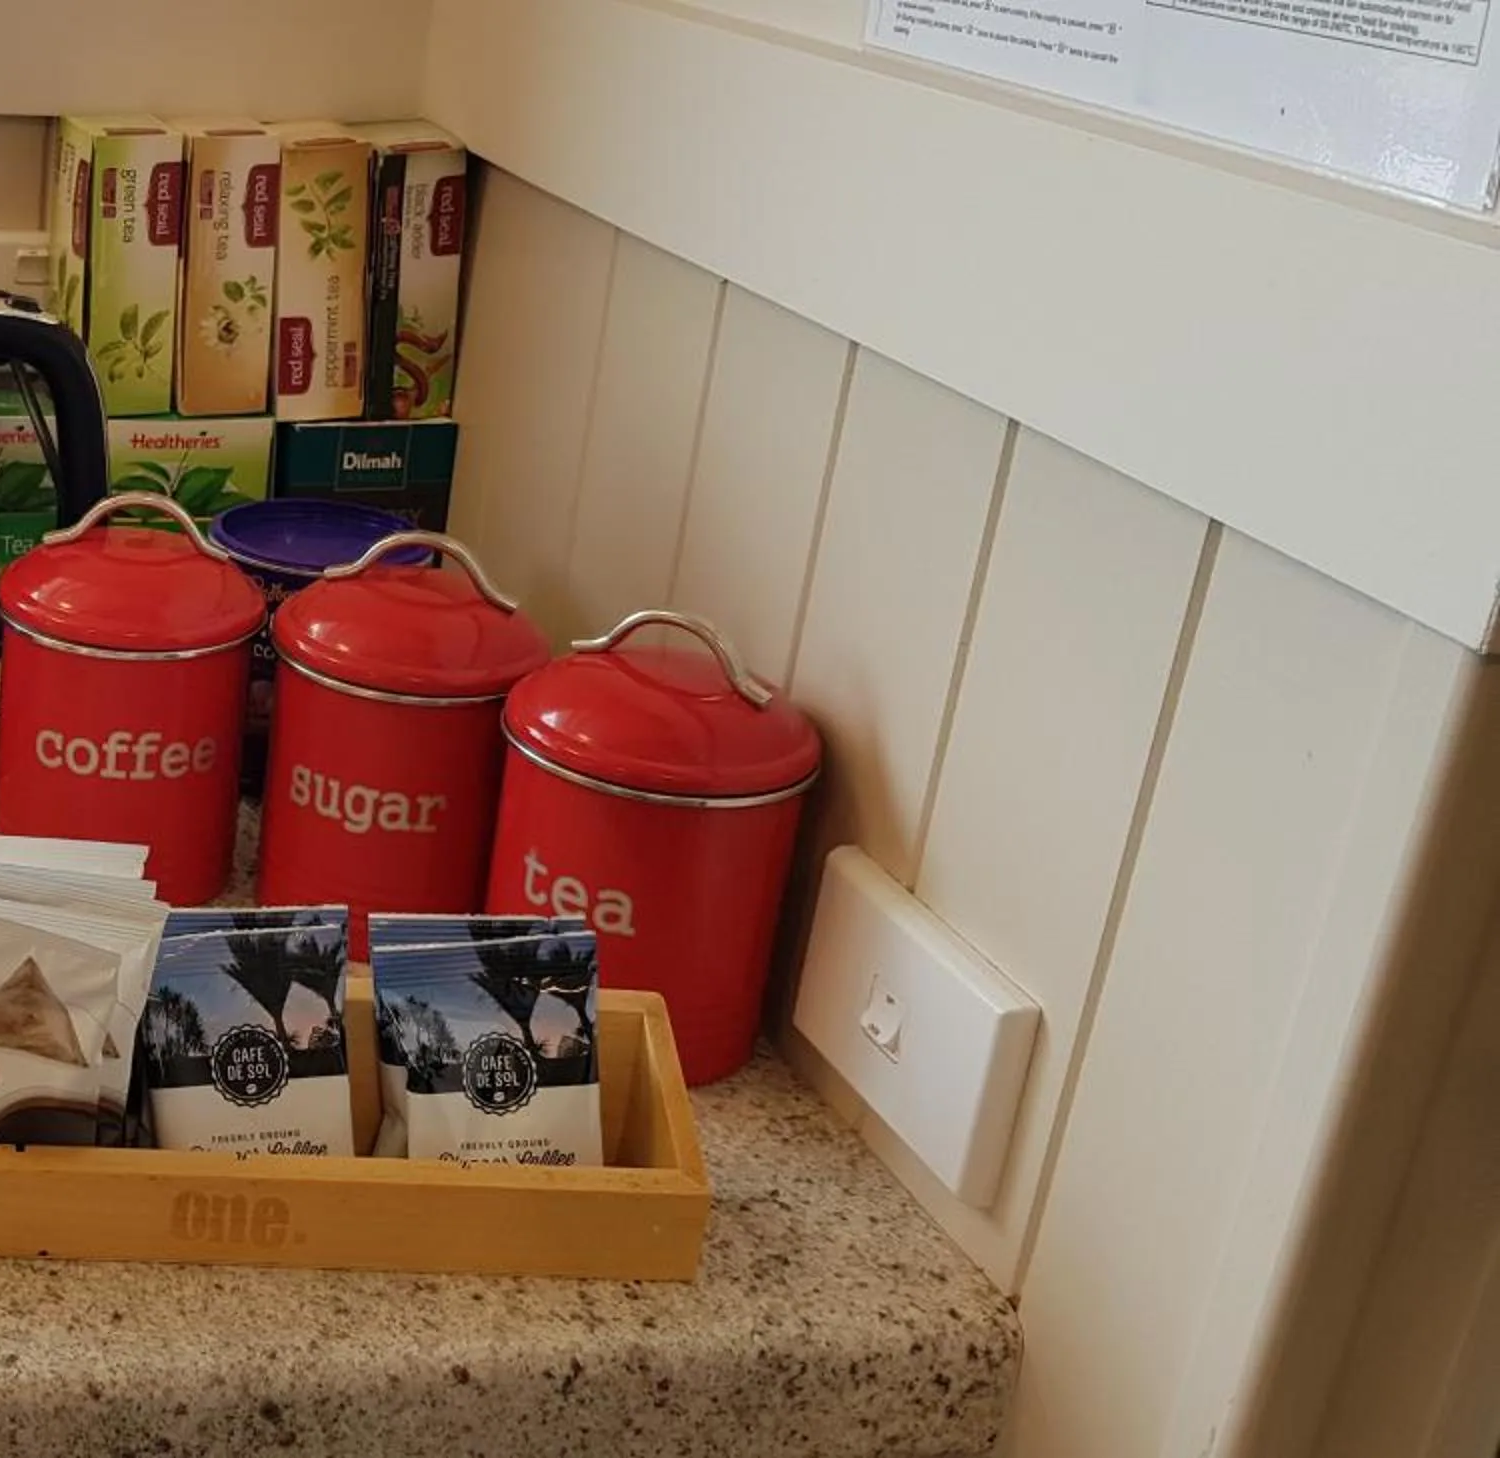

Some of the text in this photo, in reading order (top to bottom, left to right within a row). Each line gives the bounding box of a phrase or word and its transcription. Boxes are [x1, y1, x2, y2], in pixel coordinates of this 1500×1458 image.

[120, 168, 137, 243] green tea
[156, 172, 171, 236] red seal
[213, 170, 232, 261] relaxing tea
[253, 174, 267, 238] red seal
[438, 185, 454, 247] red seal
[288, 327, 305, 386] red seal
[325, 275, 341, 389] peppermint tea
[130, 430, 222, 449] Healtheries
[342, 451, 404, 471] Dilmah
[4, 535, 35, 554] Tea
[36, 729, 217, 783] coffee
[290, 763, 446, 834] sugar
[523, 848, 636, 937] tea
[227, 1064, 244, 1081] DE
[233, 1046, 265, 1063] CAFE
[476, 1071, 492, 1089] DE
[481, 1055, 513, 1071] CAFE
